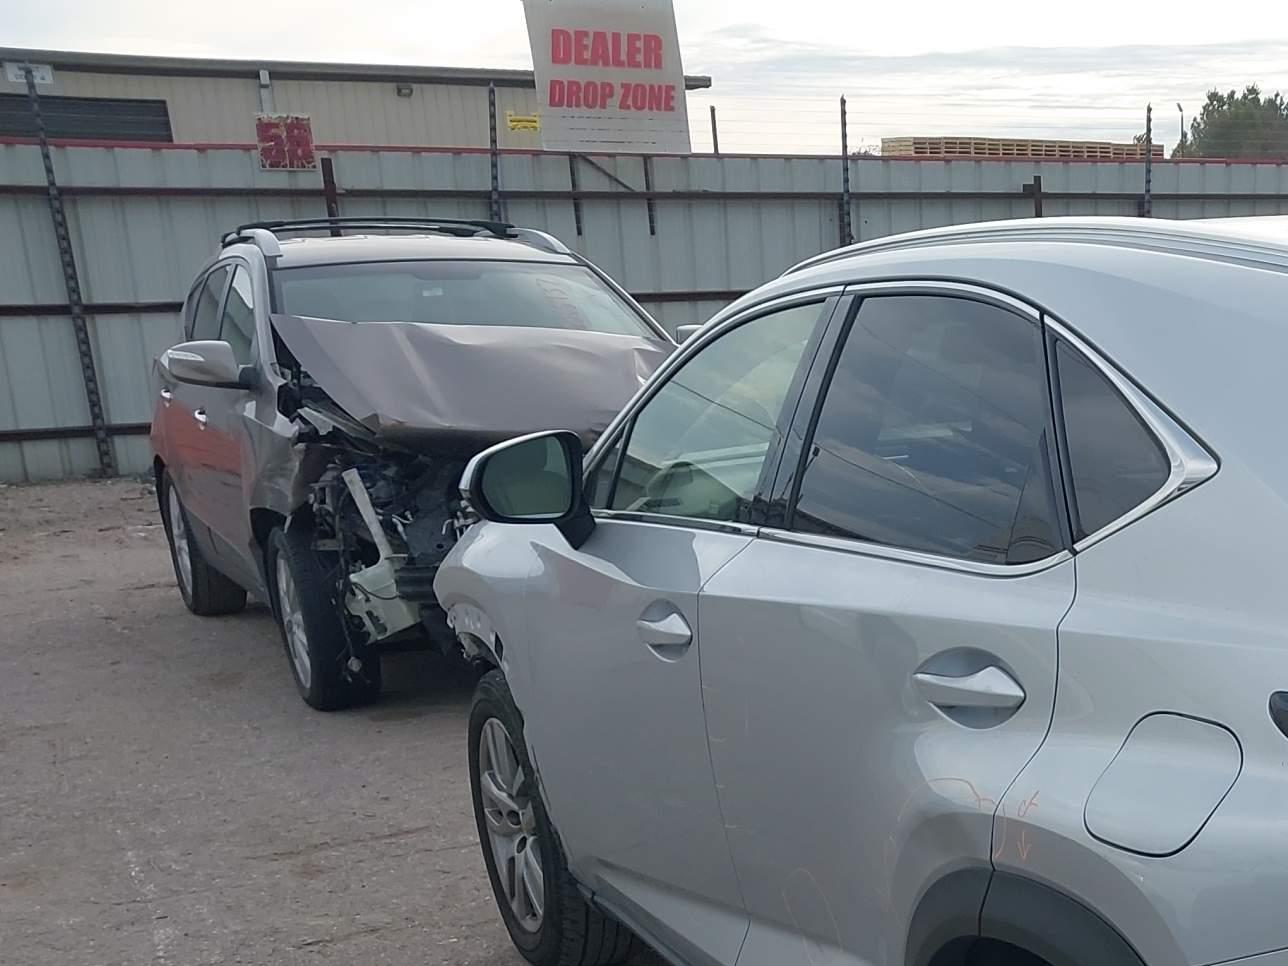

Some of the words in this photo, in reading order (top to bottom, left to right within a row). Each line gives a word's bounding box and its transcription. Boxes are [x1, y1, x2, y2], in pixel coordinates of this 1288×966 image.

[551, 28, 663, 70] DEALER
[549, 79, 614, 110] DROP
[619, 83, 675, 112] ZONE
